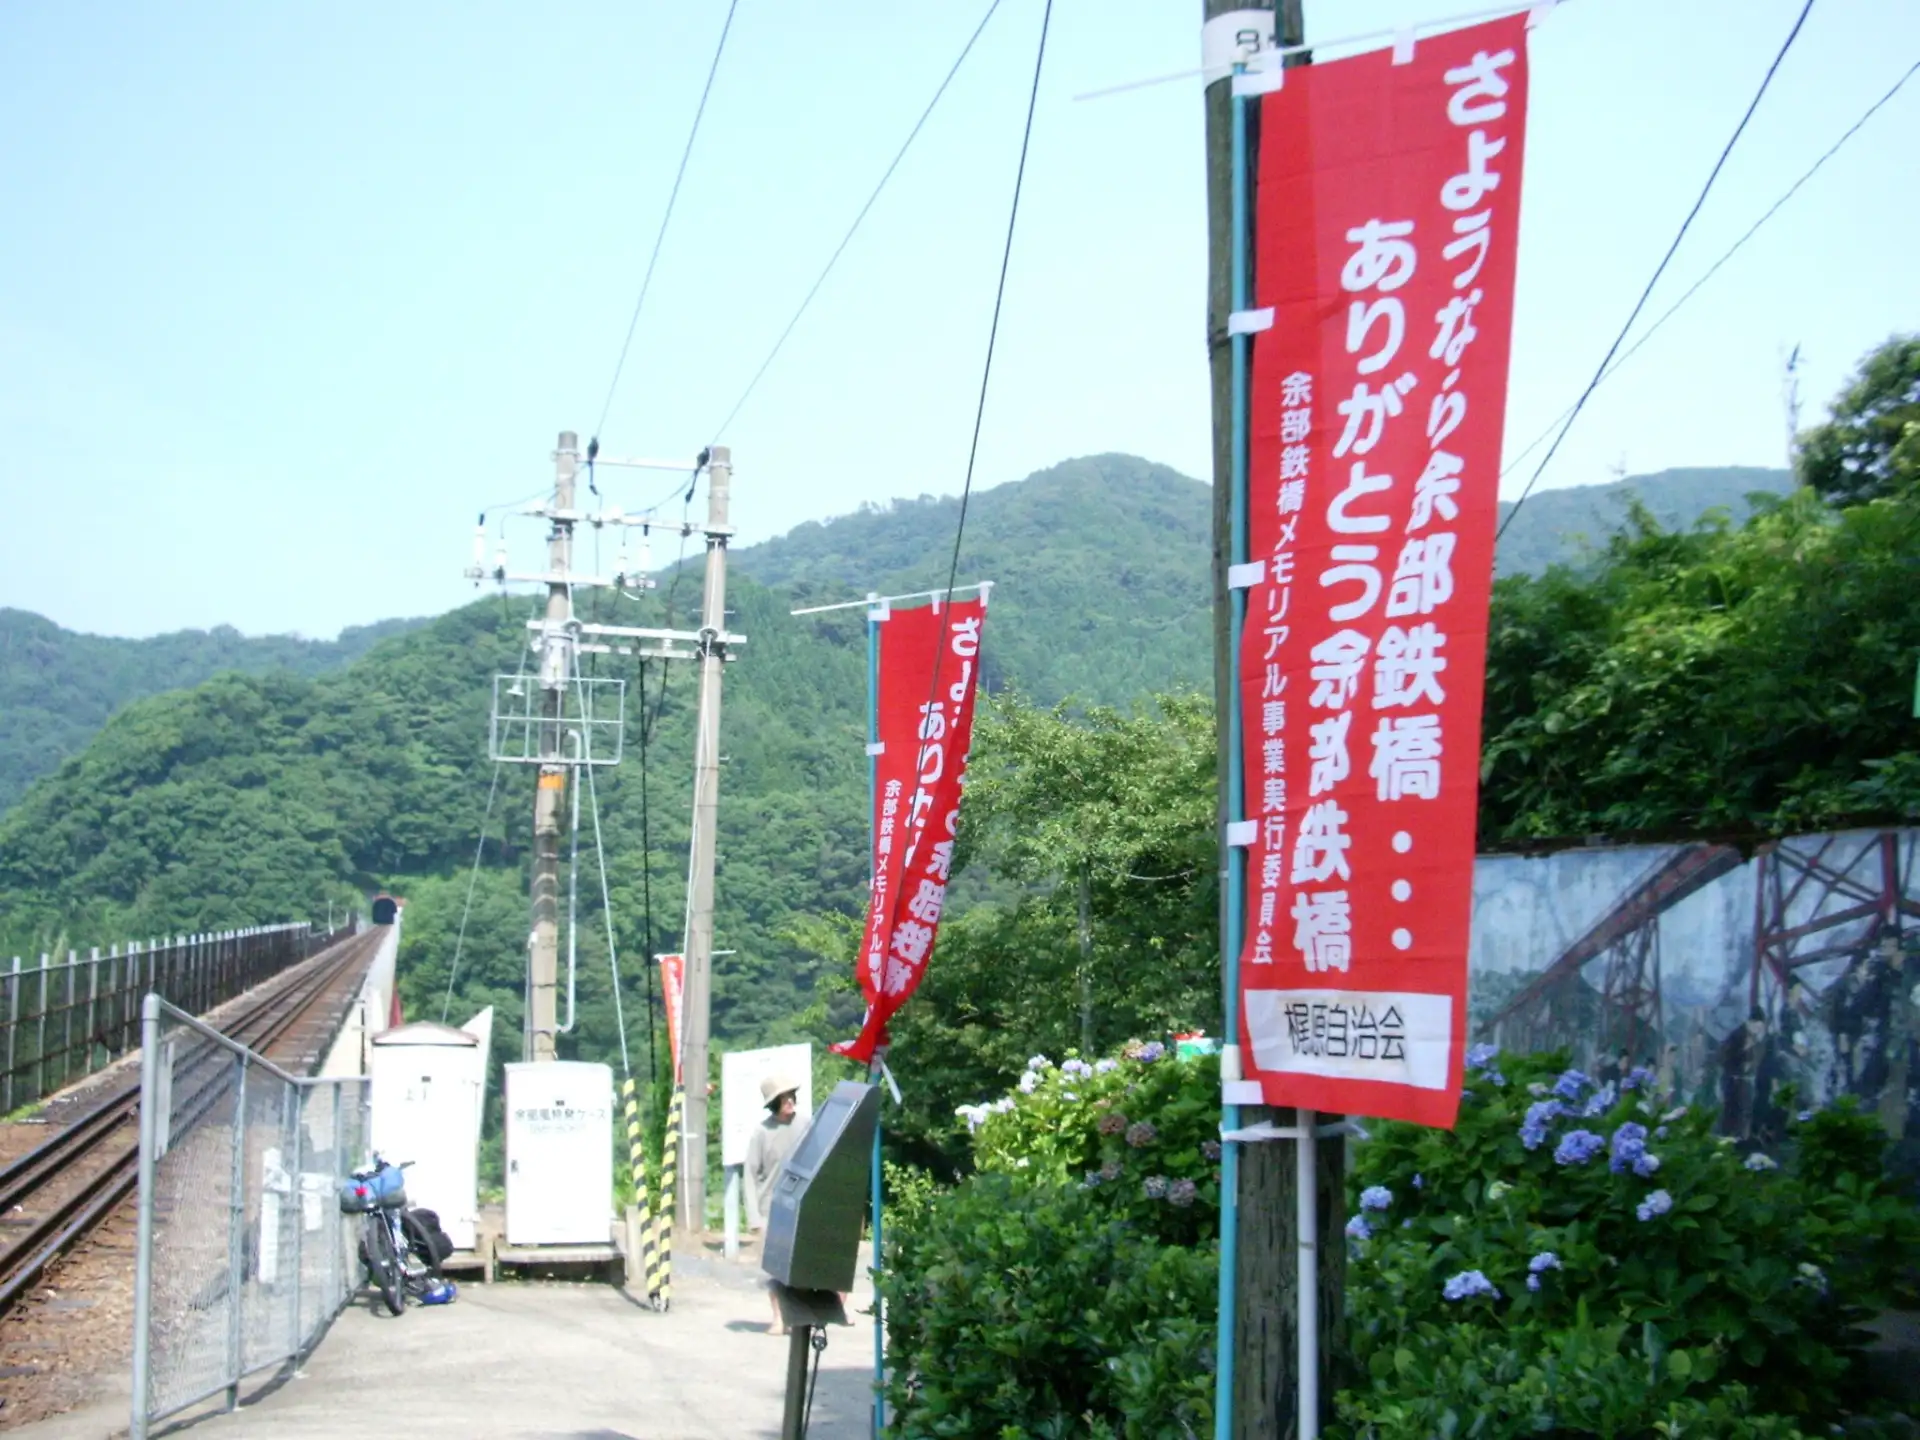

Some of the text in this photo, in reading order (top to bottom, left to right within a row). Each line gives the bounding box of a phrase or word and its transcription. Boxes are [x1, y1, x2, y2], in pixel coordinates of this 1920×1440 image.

[1251, 371, 1312, 965] 余部鉄橋メモリアル事業実行委員会
[1290, 218, 1418, 974] ありがとう余部鉄橋
[1284, 1003, 1405, 1061] 梶原自治会
